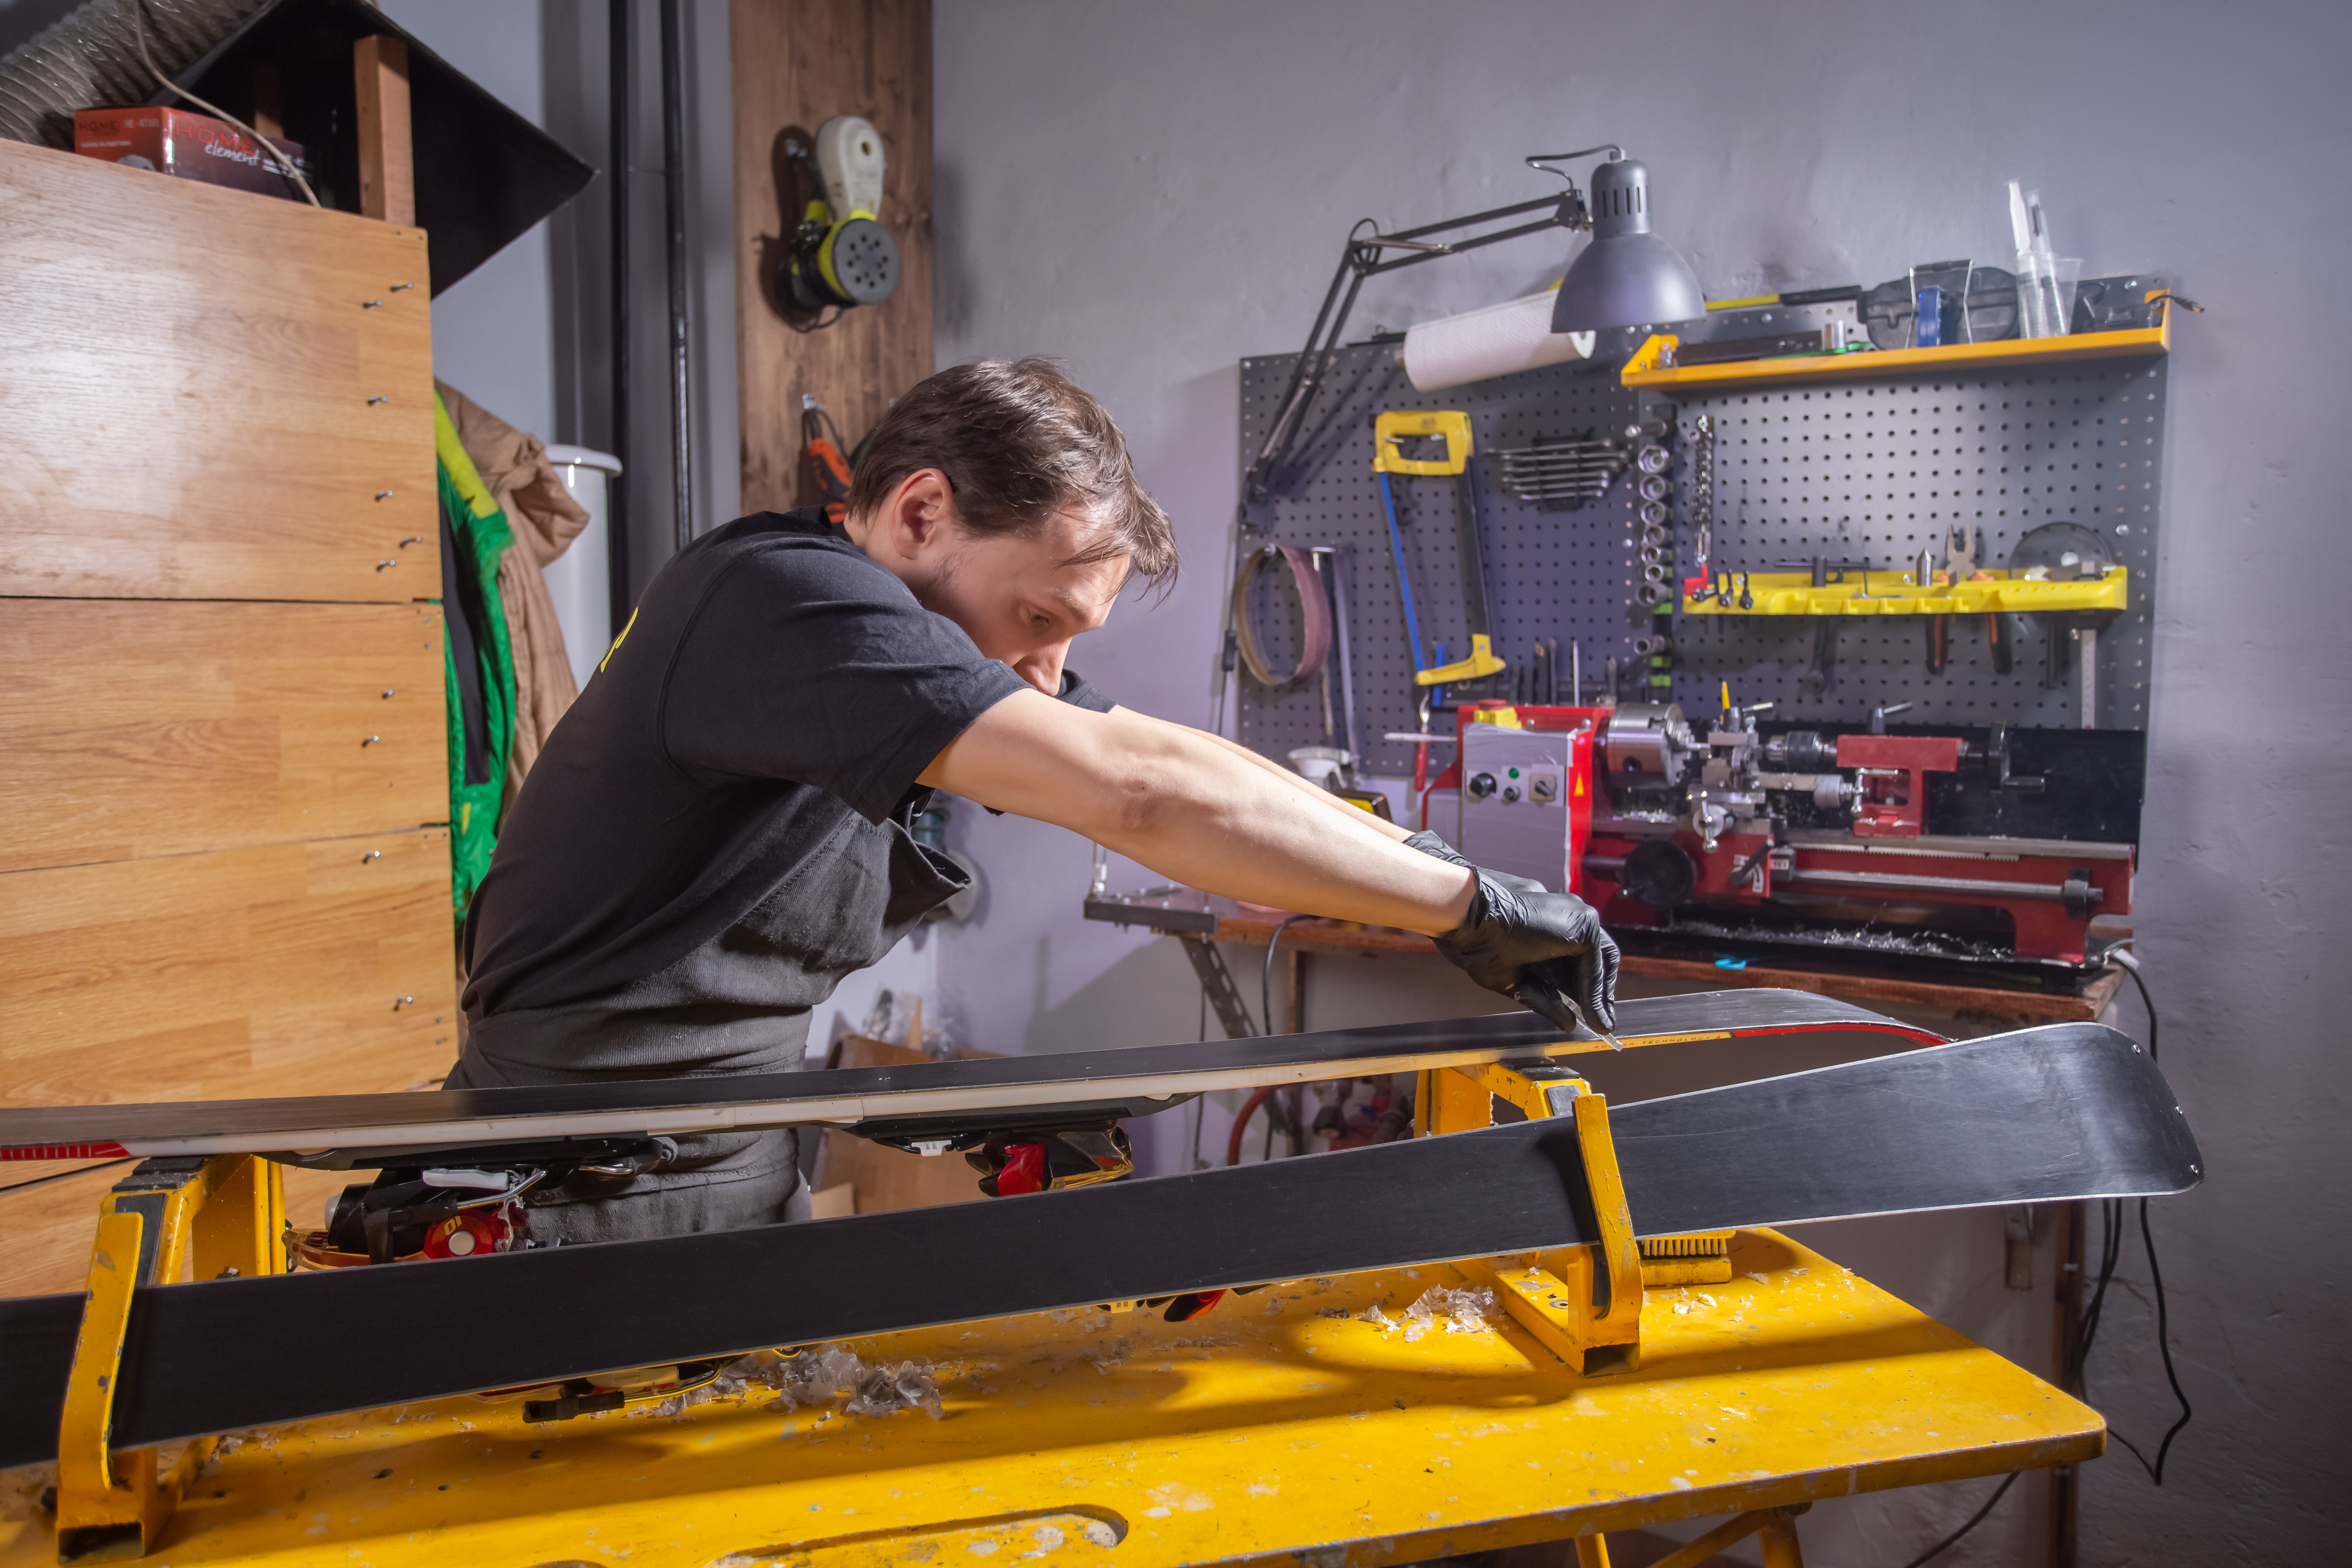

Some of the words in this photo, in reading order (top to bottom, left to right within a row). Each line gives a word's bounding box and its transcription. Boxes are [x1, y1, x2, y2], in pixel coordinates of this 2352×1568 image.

[175, 122, 255, 156] HOME
[205, 138, 260, 166] element
[1642, 1036, 1711, 1044] TECHNOLOGY
